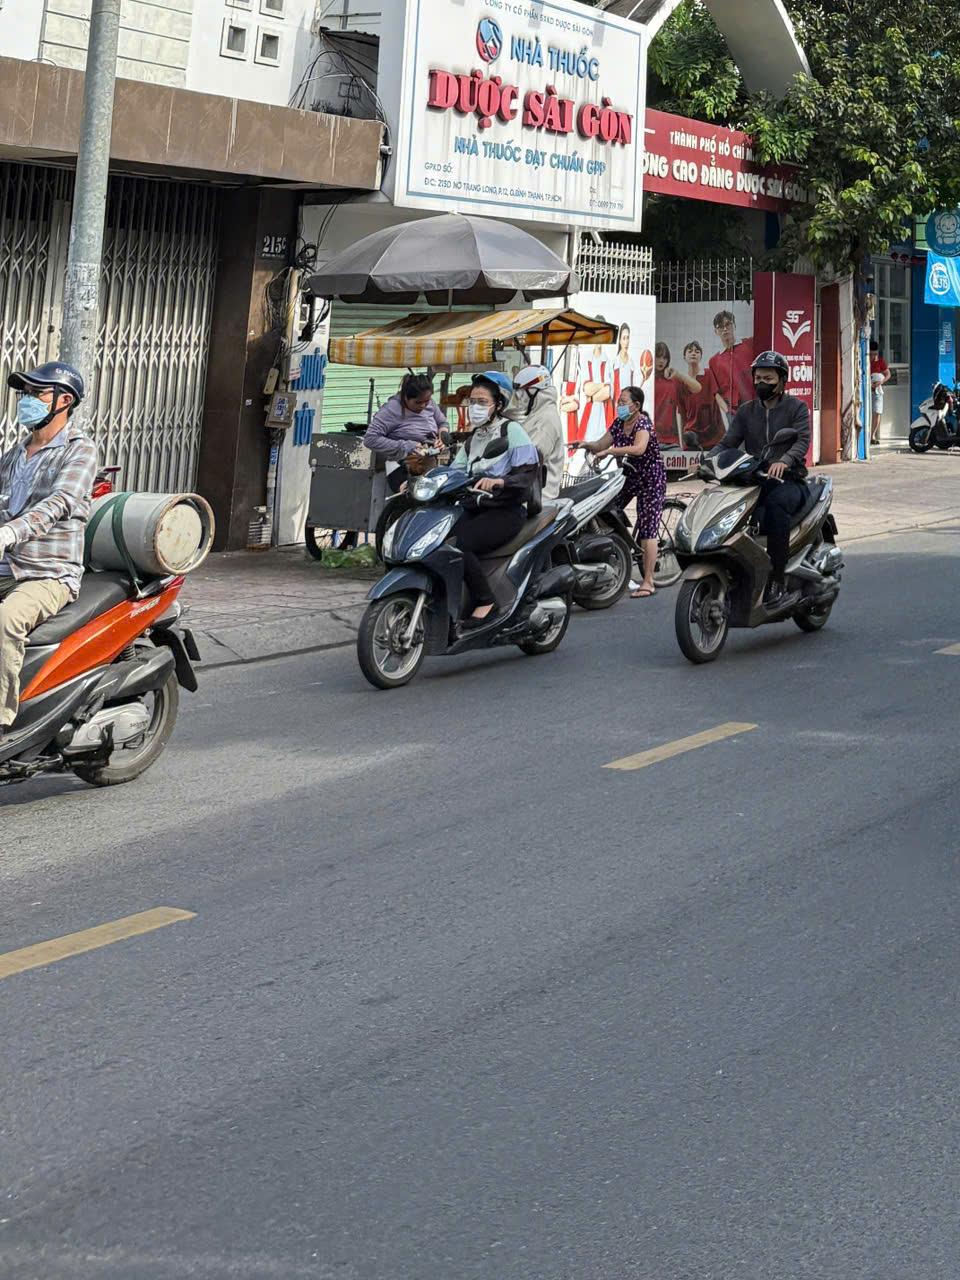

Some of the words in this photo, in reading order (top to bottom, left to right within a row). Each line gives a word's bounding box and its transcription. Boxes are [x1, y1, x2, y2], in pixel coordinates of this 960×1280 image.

[504, 3, 512, 12] TY
[510, 33, 543, 68] NHÀ
[548, 46, 600, 81] THUỐC
[426, 69, 519, 129] DƯỢC
[522, 84, 576, 134] SÀI
[578, 96, 633, 145] GÒN
[454, 134, 479, 157] NHÀ
[482, 139, 522, 162] THUỐC
[524, 148, 547, 171] ĐẠT
[586, 160, 606, 176] GPP
[669, 127, 698, 150] THÀNH
[699, 134, 717, 154] PHỐ
[732, 141, 745, 160] CHÍ
[672, 159, 698, 184] CAO
[700, 154, 734, 191] ĐẲNG
[736, 171, 766, 201] DƯỢC
